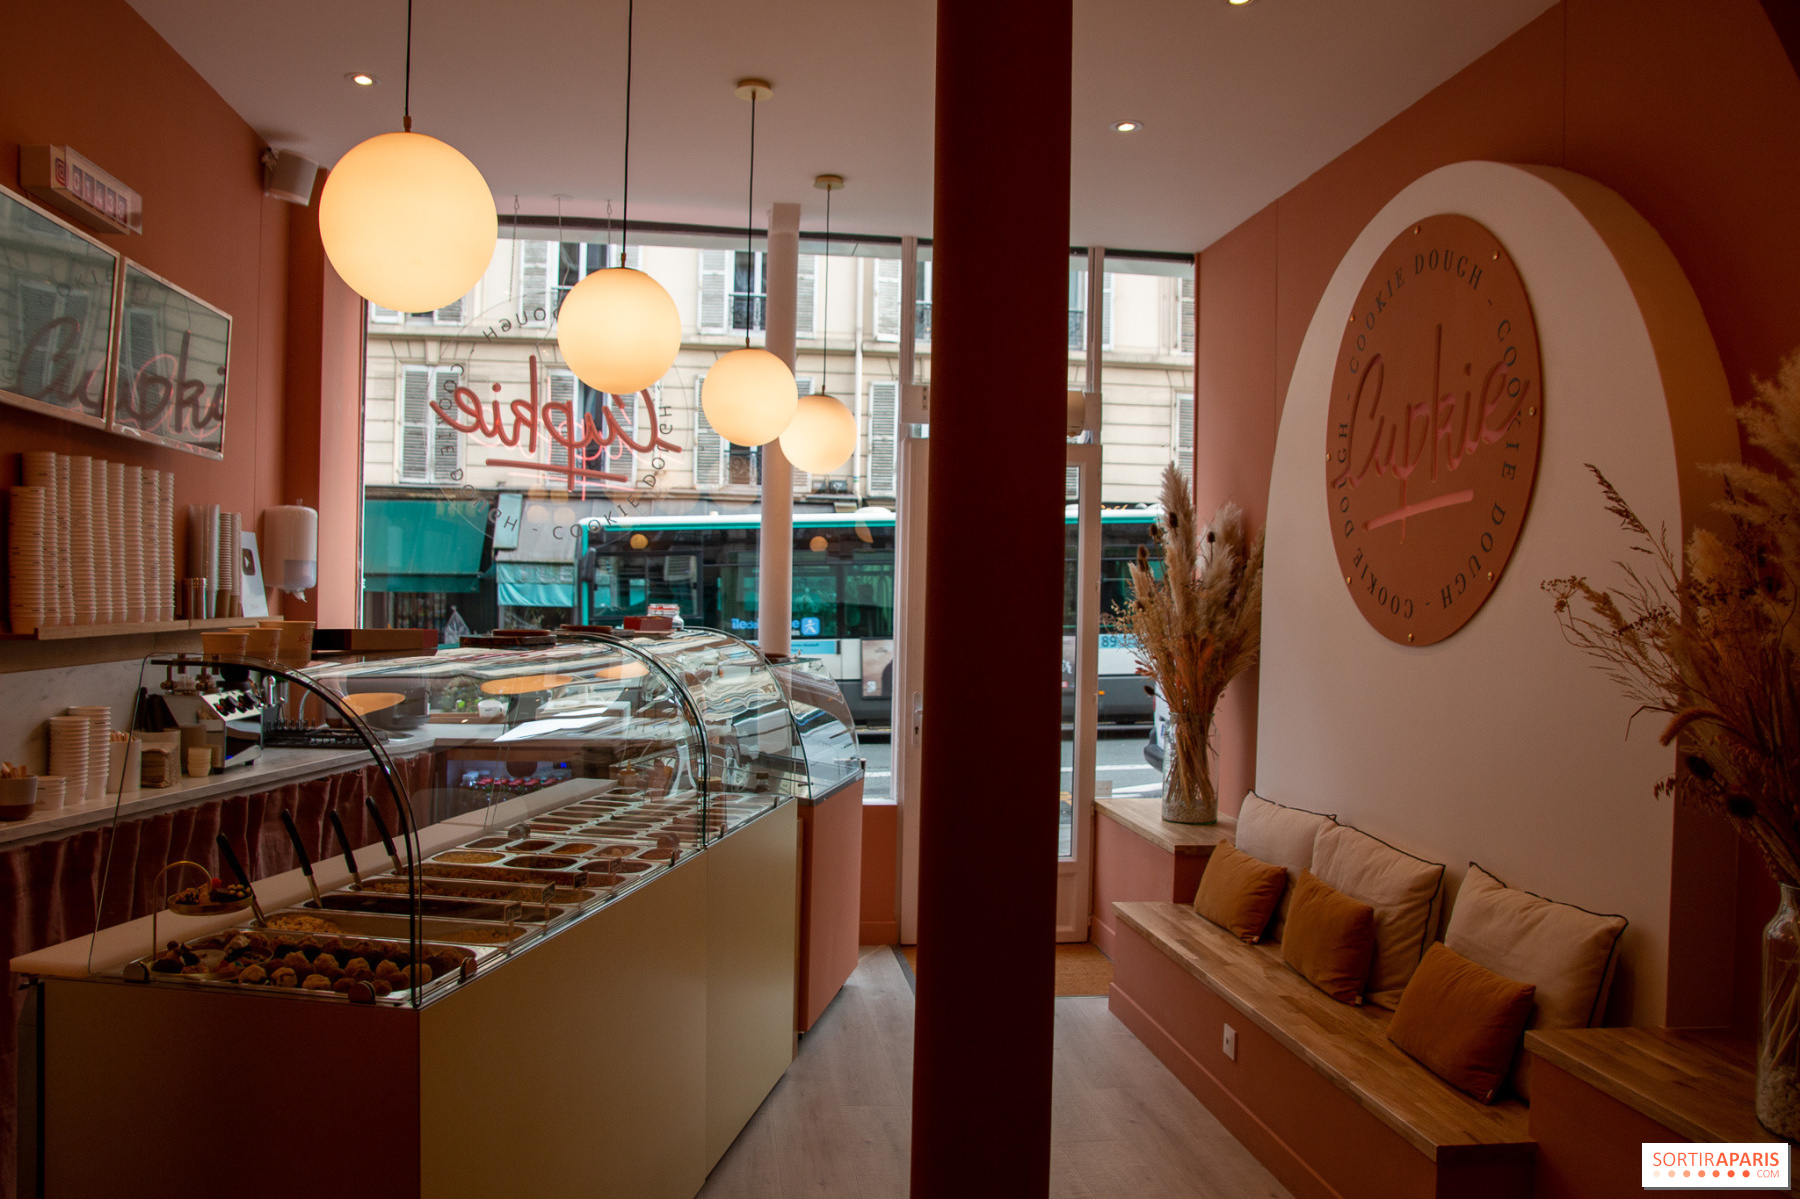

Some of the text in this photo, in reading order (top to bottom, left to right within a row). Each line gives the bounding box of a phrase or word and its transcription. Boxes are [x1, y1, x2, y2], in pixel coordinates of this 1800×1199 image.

[1350, 249, 1482, 374] COOKIE DOUGH
[1353, 547, 1413, 619] COOKIE
[1441, 502, 1505, 609] DOUGH
[1101, 635, 1118, 647] 89
